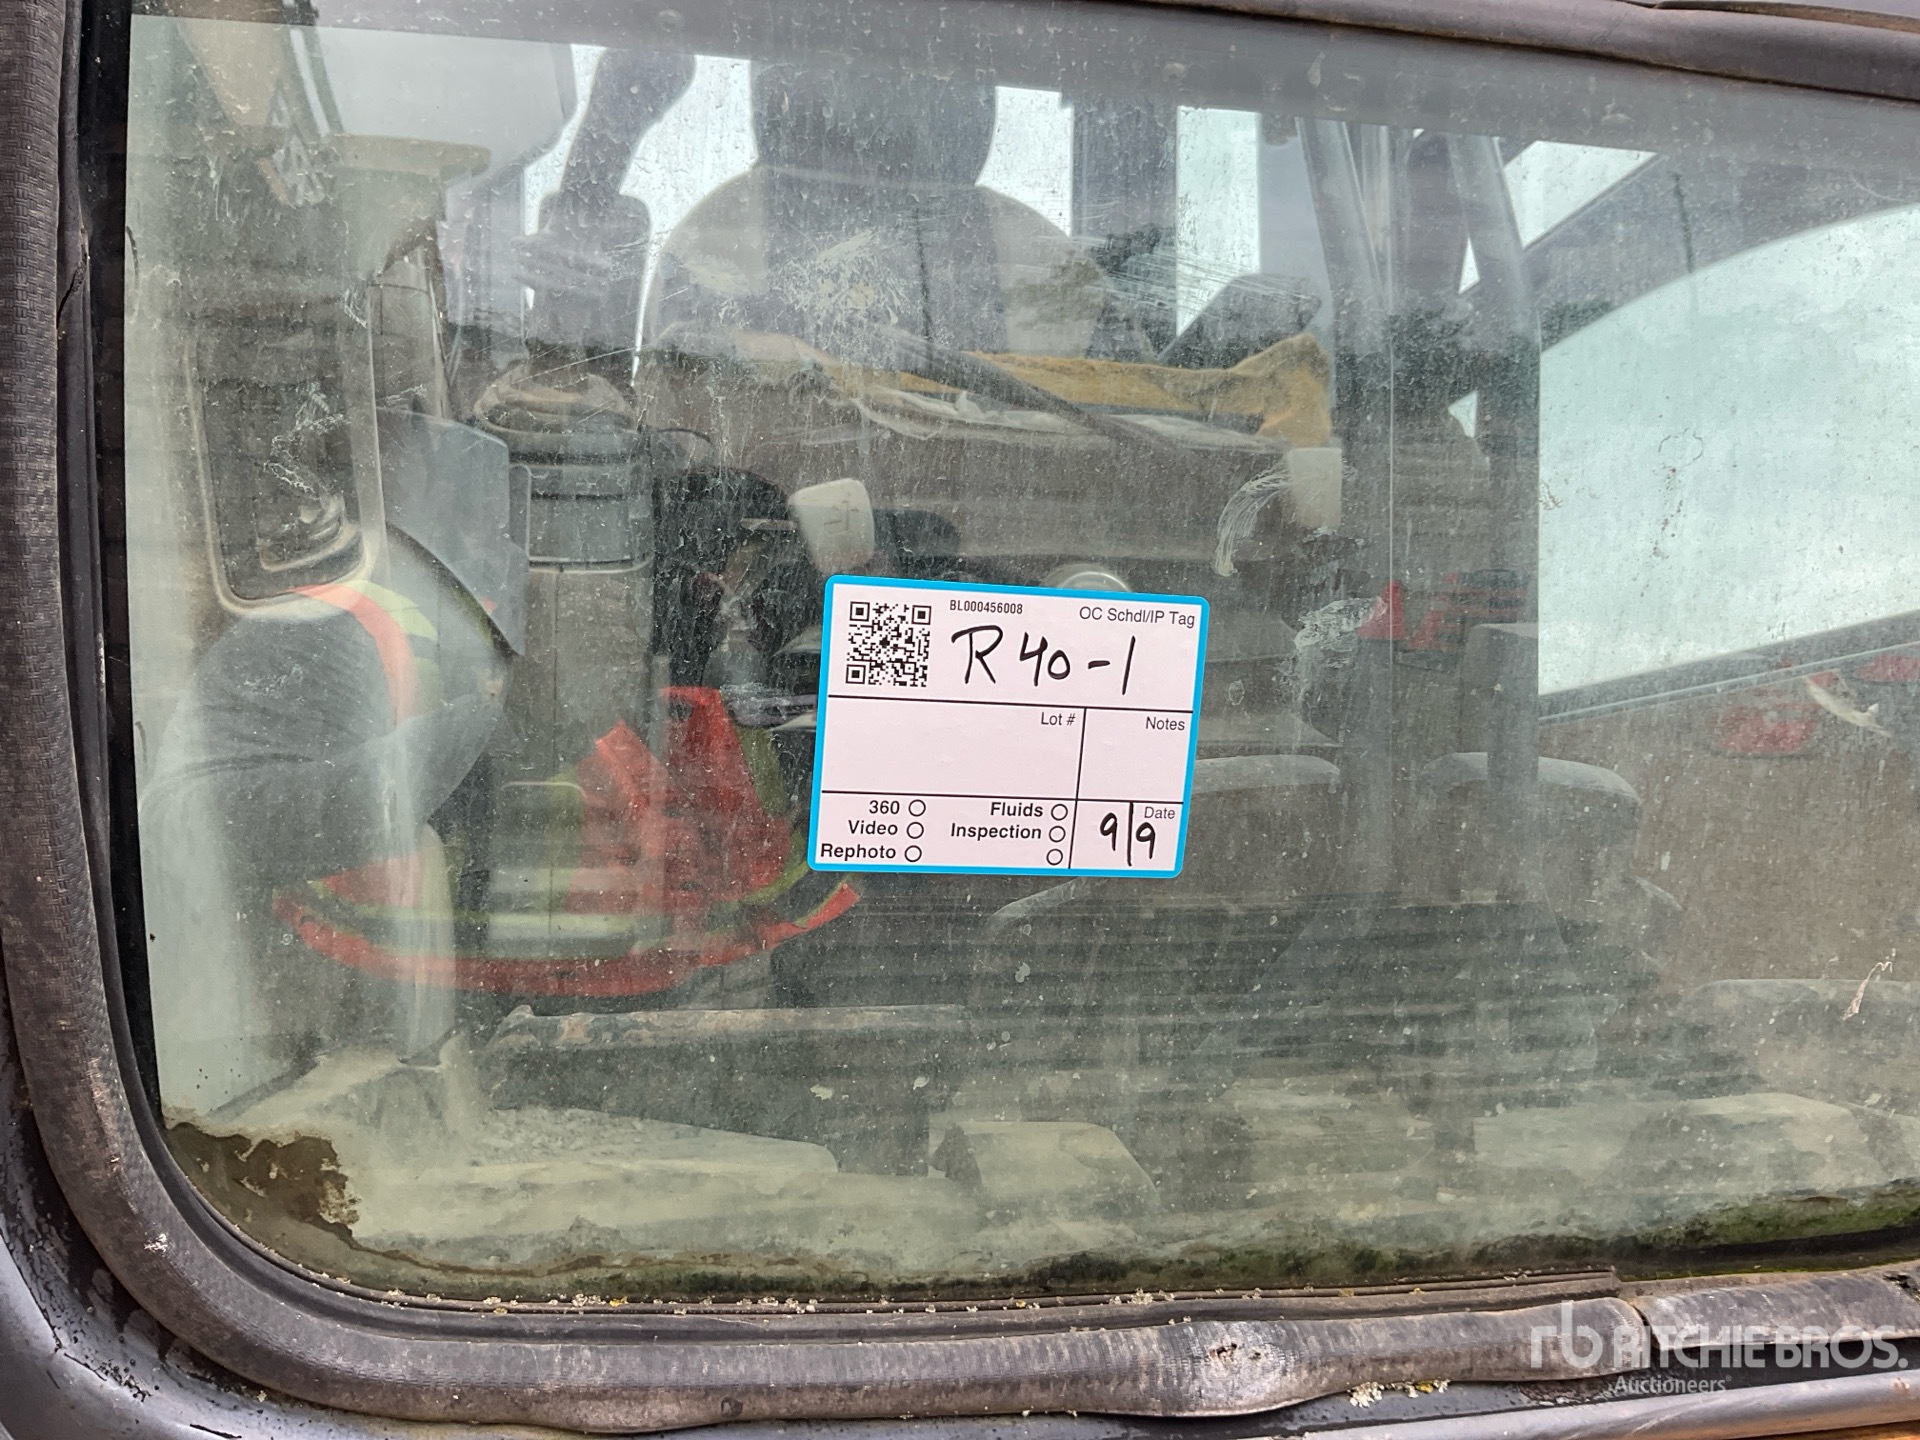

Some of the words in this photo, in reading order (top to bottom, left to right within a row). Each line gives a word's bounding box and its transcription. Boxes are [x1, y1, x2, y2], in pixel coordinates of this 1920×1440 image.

[949, 600, 1023, 615] BL000456008
[1079, 606, 1103, 620] OC
[1169, 613, 1195, 629] Tag
[951, 625, 1003, 685] R
[1040, 712, 1062, 726] Lot
[1065, 713, 1076, 725] #
[1145, 717, 1185, 731] Notes
[868, 801, 899, 814] 360
[990, 802, 1043, 818] Fluids
[1144, 806, 1175, 820] Date
[848, 820, 898, 835] Video
[950, 823, 1042, 842] Inspection
[820, 844, 896, 860] Rephoto
